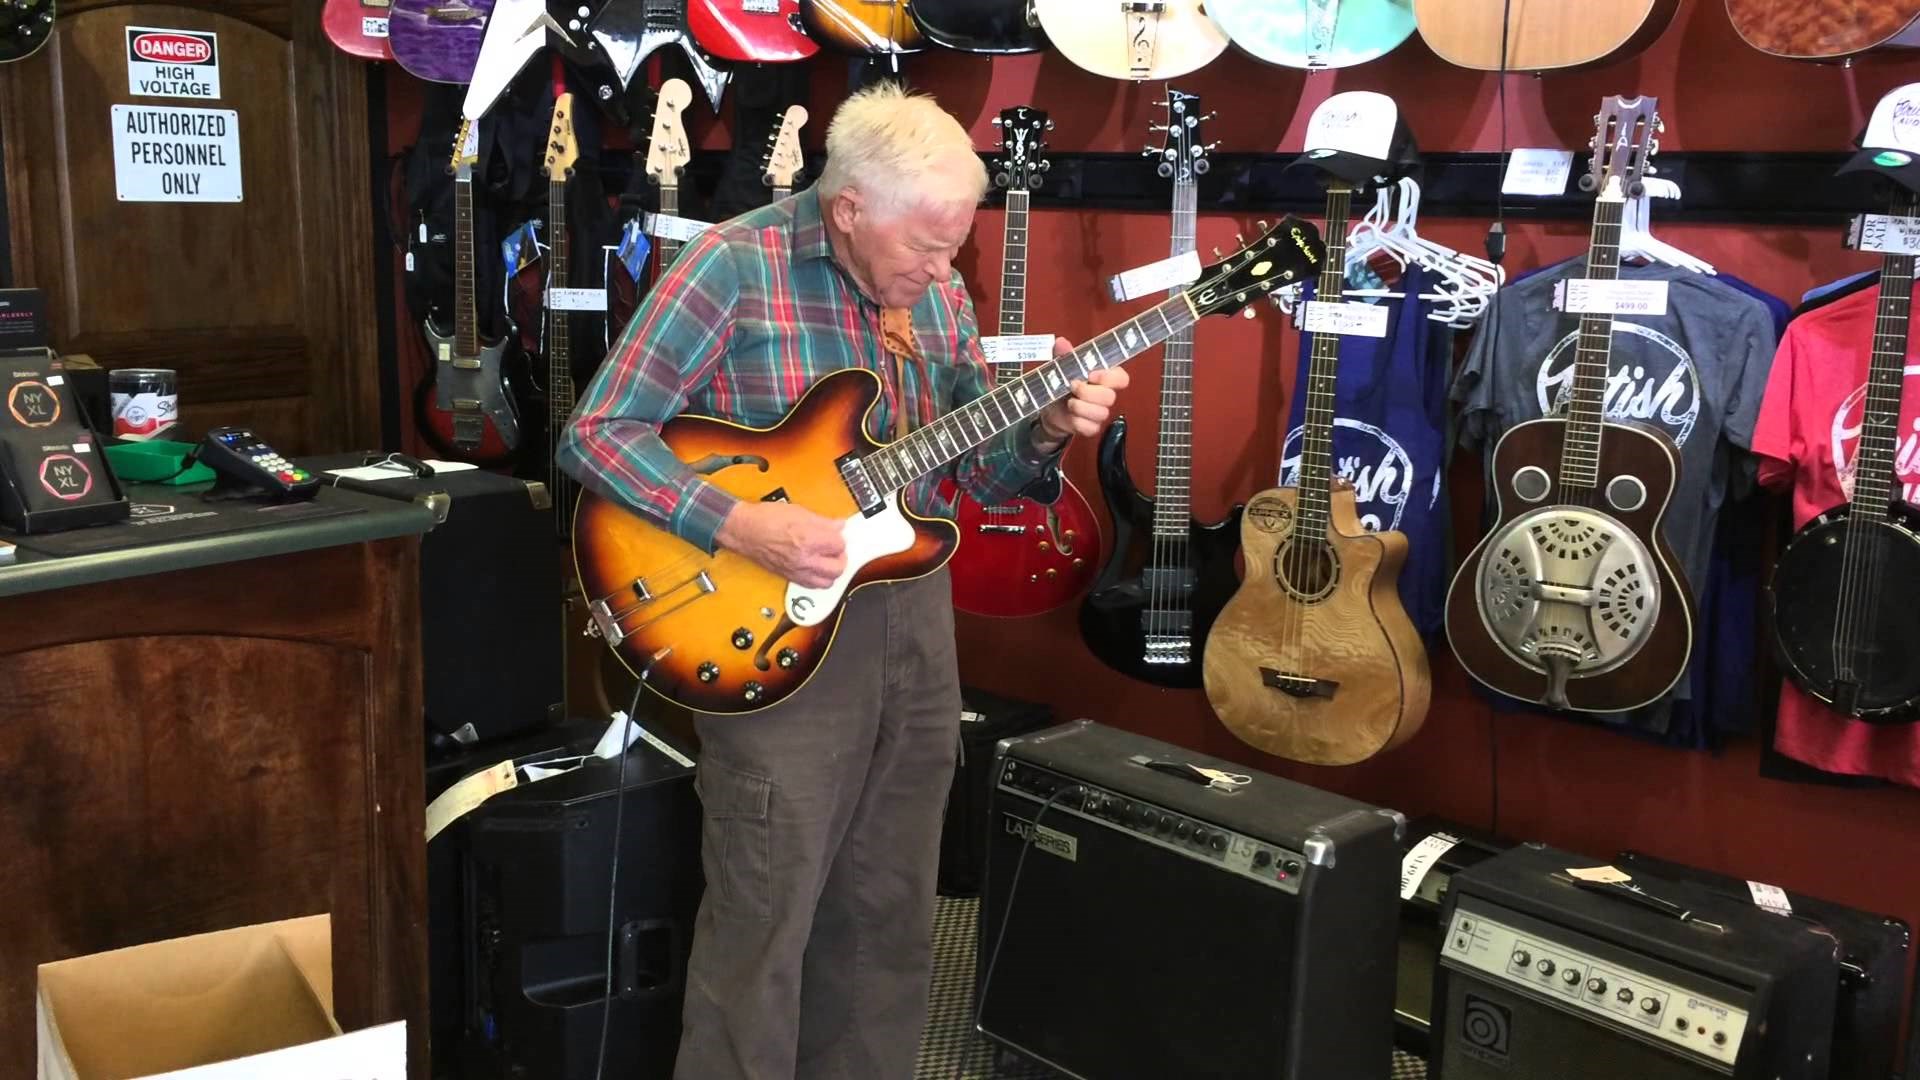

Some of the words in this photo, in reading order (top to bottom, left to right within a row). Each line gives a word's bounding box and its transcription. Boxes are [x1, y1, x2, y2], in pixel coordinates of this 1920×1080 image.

[140, 39, 207, 58] DANGER
[156, 66, 195, 80] HIGH
[140, 80, 211, 96] VOLTAGE
[127, 111, 226, 137] AUTHORIZED
[131, 141, 226, 166] PERSONNEL
[162, 172, 201, 195] ONLY
[23, 393, 43, 404] NY
[27, 405, 47, 416] XL
[53, 465, 73, 476] NY
[58, 477, 79, 488] XL
